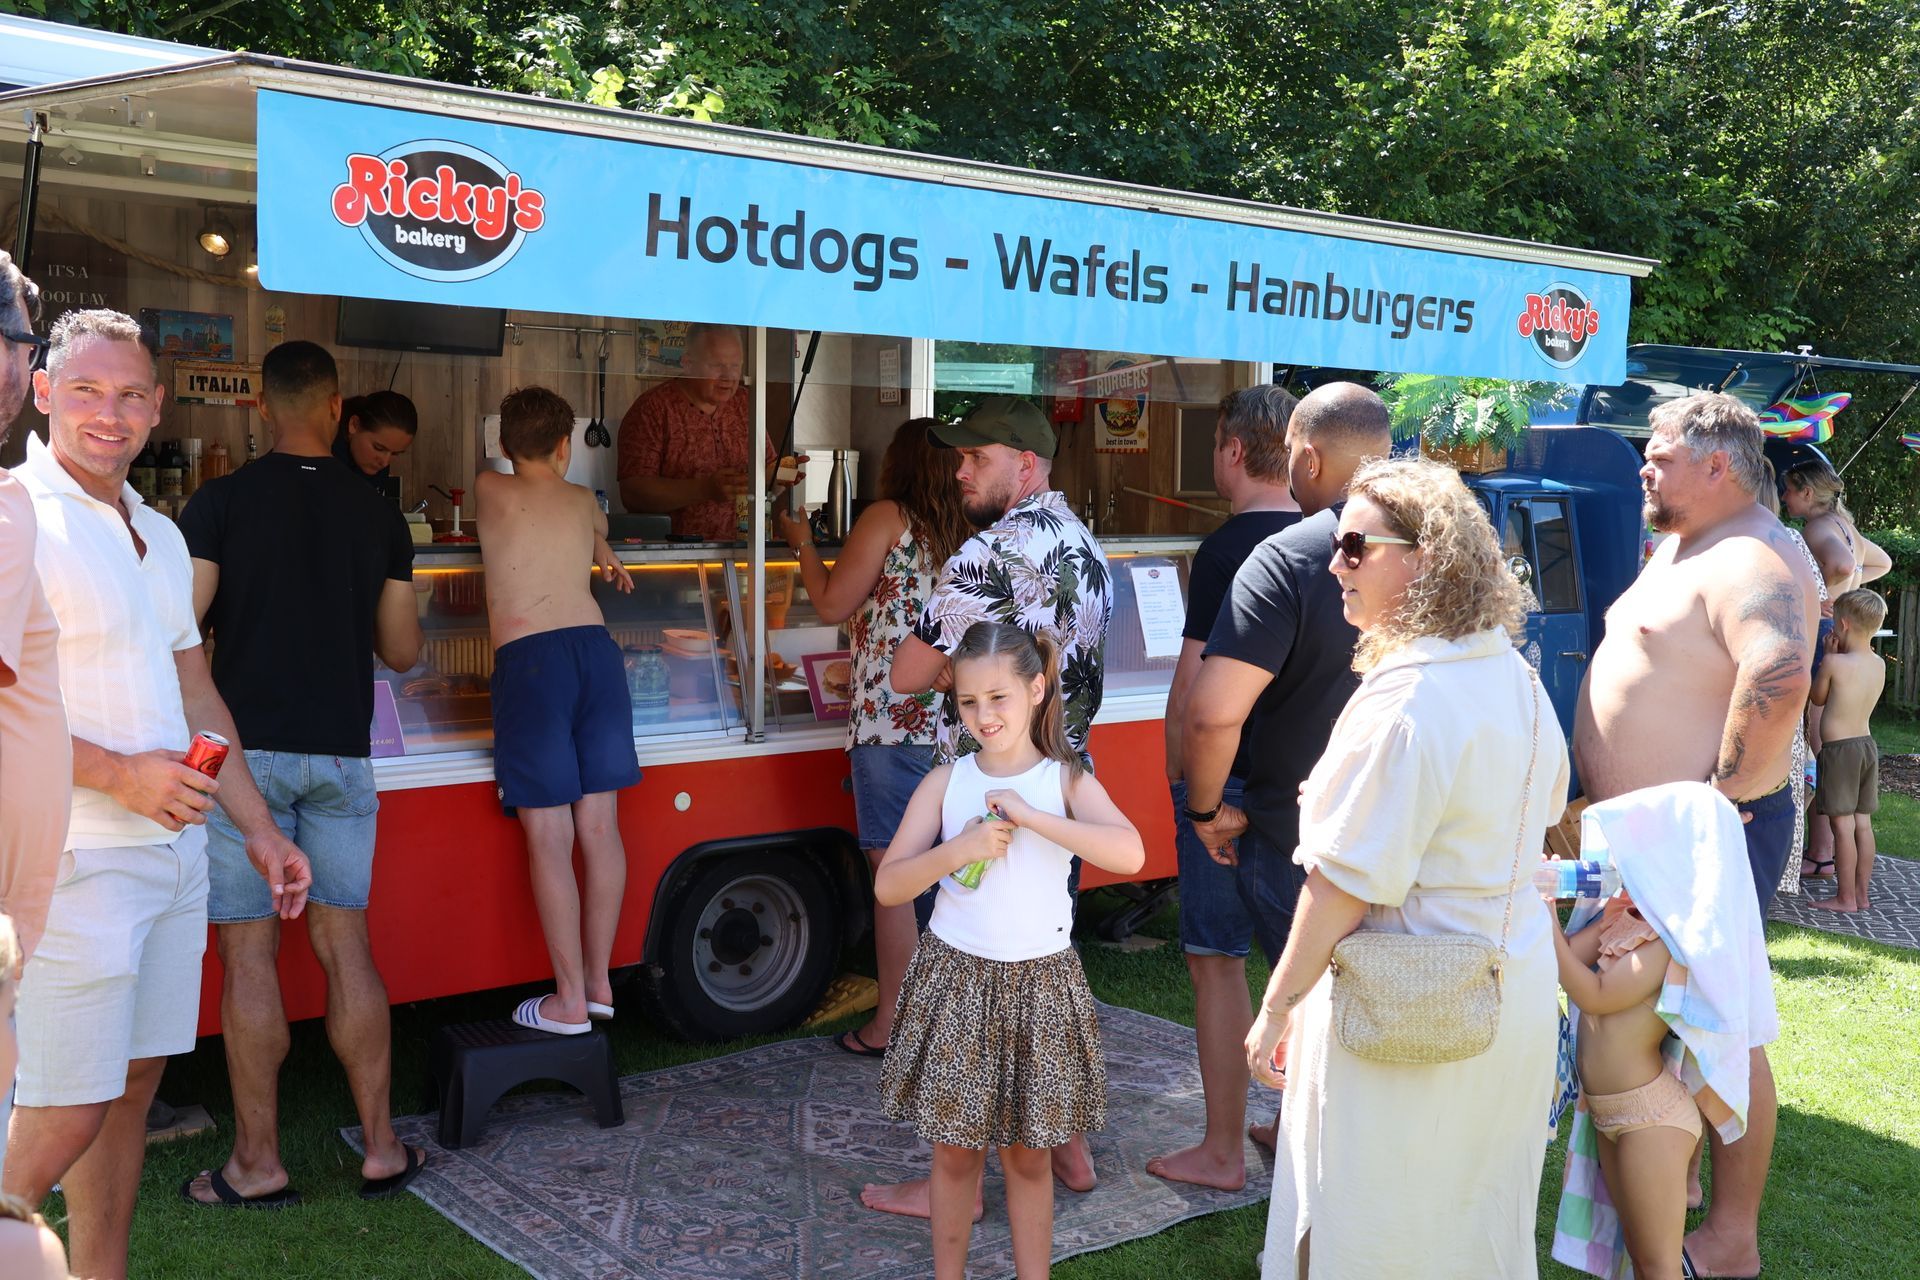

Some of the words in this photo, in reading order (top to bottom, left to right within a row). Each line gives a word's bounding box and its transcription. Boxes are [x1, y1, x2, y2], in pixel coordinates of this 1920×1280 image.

[332, 153, 545, 241] Ricky's
[394, 224, 466, 254] bakery
[78, 266, 89, 279] A
[646, 193, 918, 291] Hotdogs
[993, 233, 1168, 303] Wafels
[1226, 261, 1475, 339] Hamburgers
[41, 289, 77, 304] OOD
[1517, 293, 1600, 342] Ricky's
[1545, 334, 1569, 352] bakery
[189, 375, 251, 394] ITALIA
[1097, 368, 1149, 397] BURGERS
